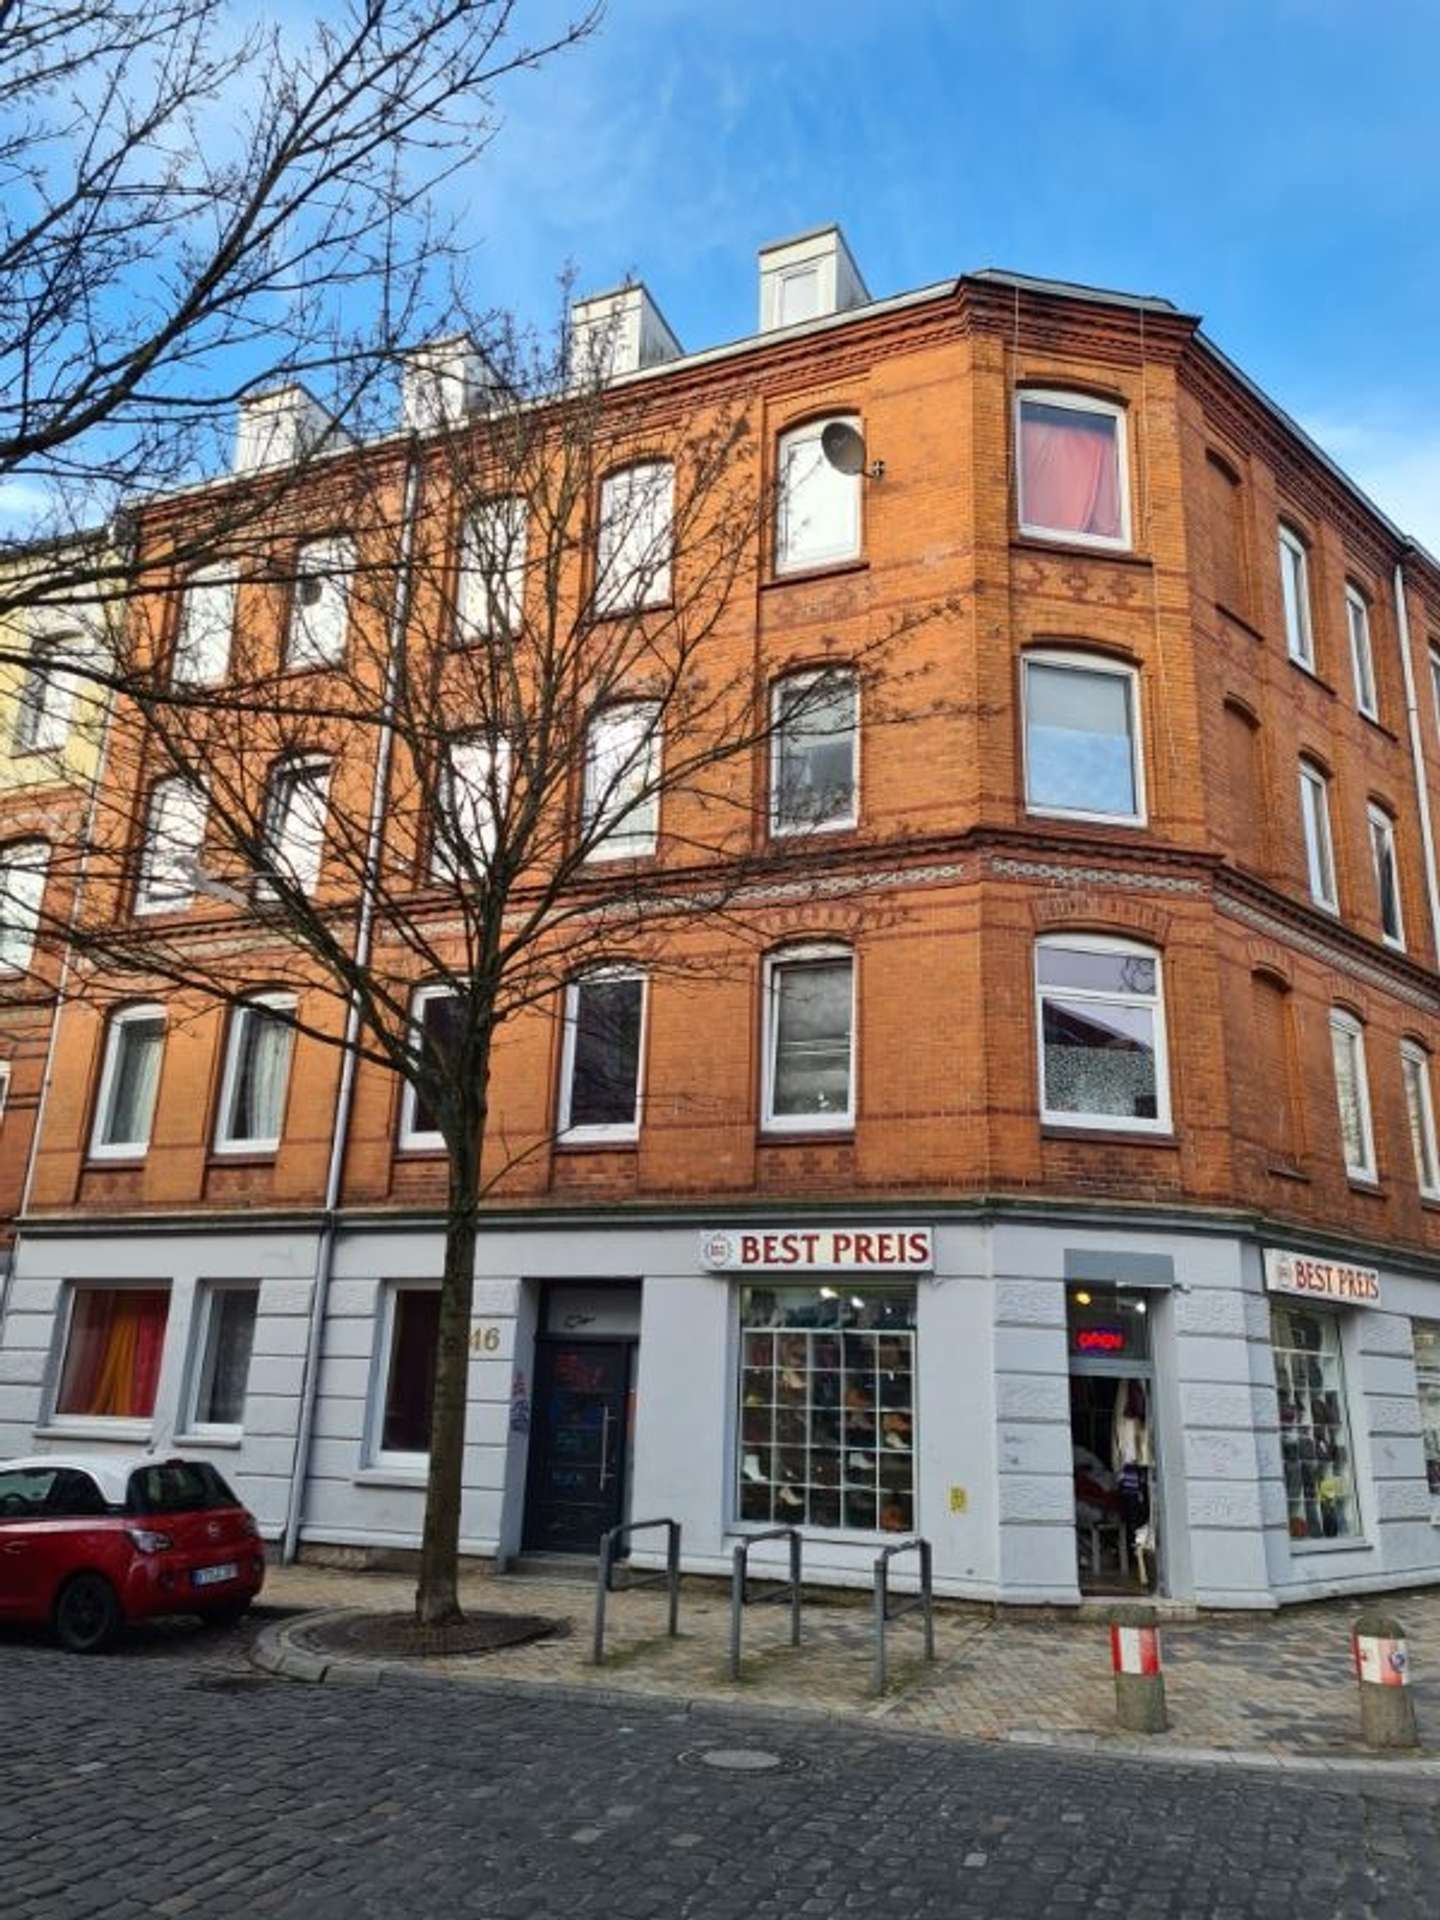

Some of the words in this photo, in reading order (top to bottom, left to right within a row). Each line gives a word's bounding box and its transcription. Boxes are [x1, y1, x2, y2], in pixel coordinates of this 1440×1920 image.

[741, 1236, 820, 1264] BEST
[832, 1233, 929, 1264] PREIS
[1295, 1260, 1333, 1294] BEST
[1337, 1267, 1379, 1299] PREIS
